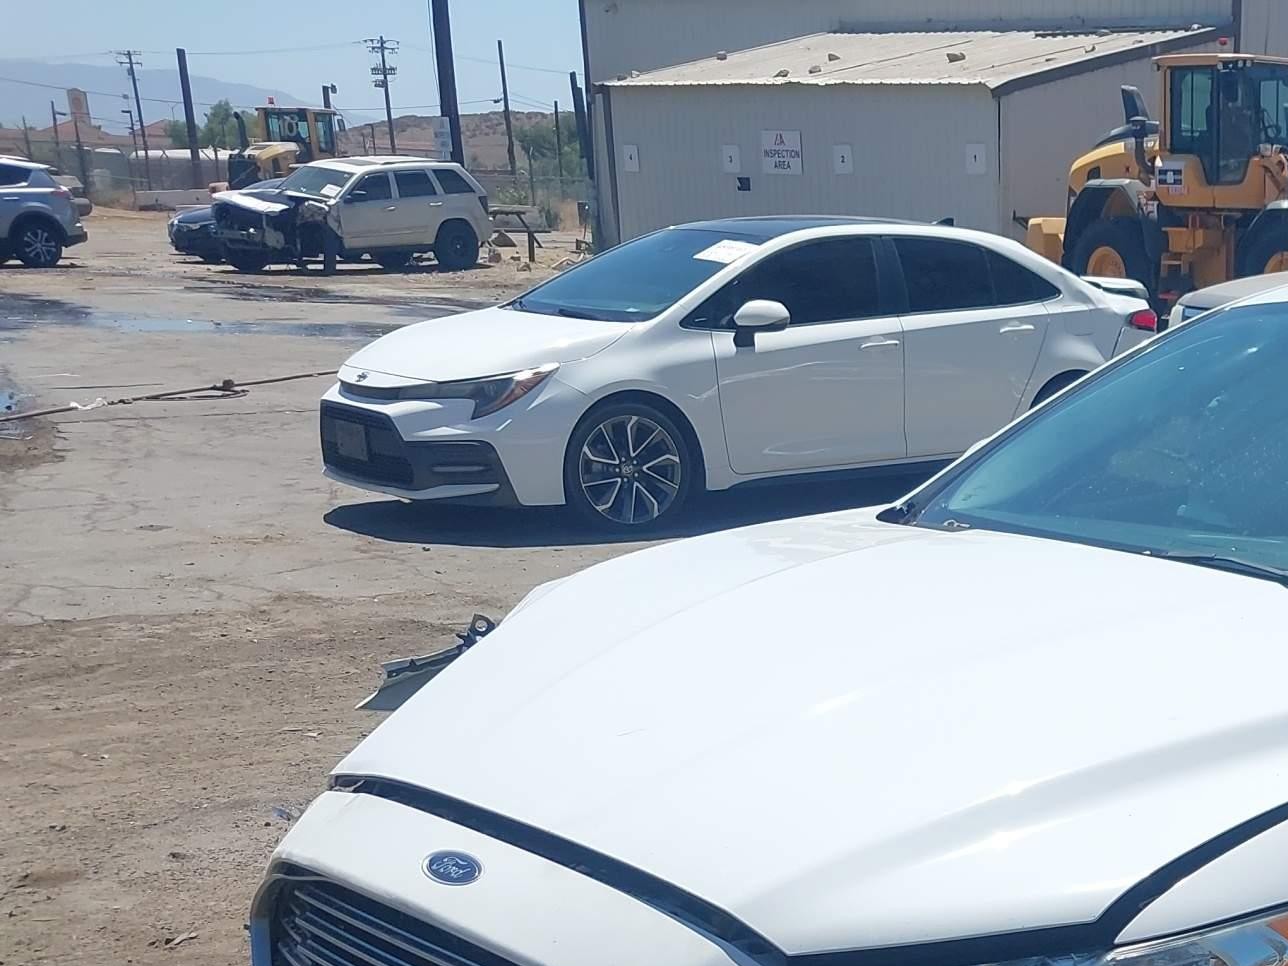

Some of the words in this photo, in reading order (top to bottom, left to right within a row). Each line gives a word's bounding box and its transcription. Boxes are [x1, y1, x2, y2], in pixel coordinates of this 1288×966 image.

[763, 149, 800, 159] INSPECTION
[774, 160, 792, 170] AREA
[430, 856, 472, 878] Ford
